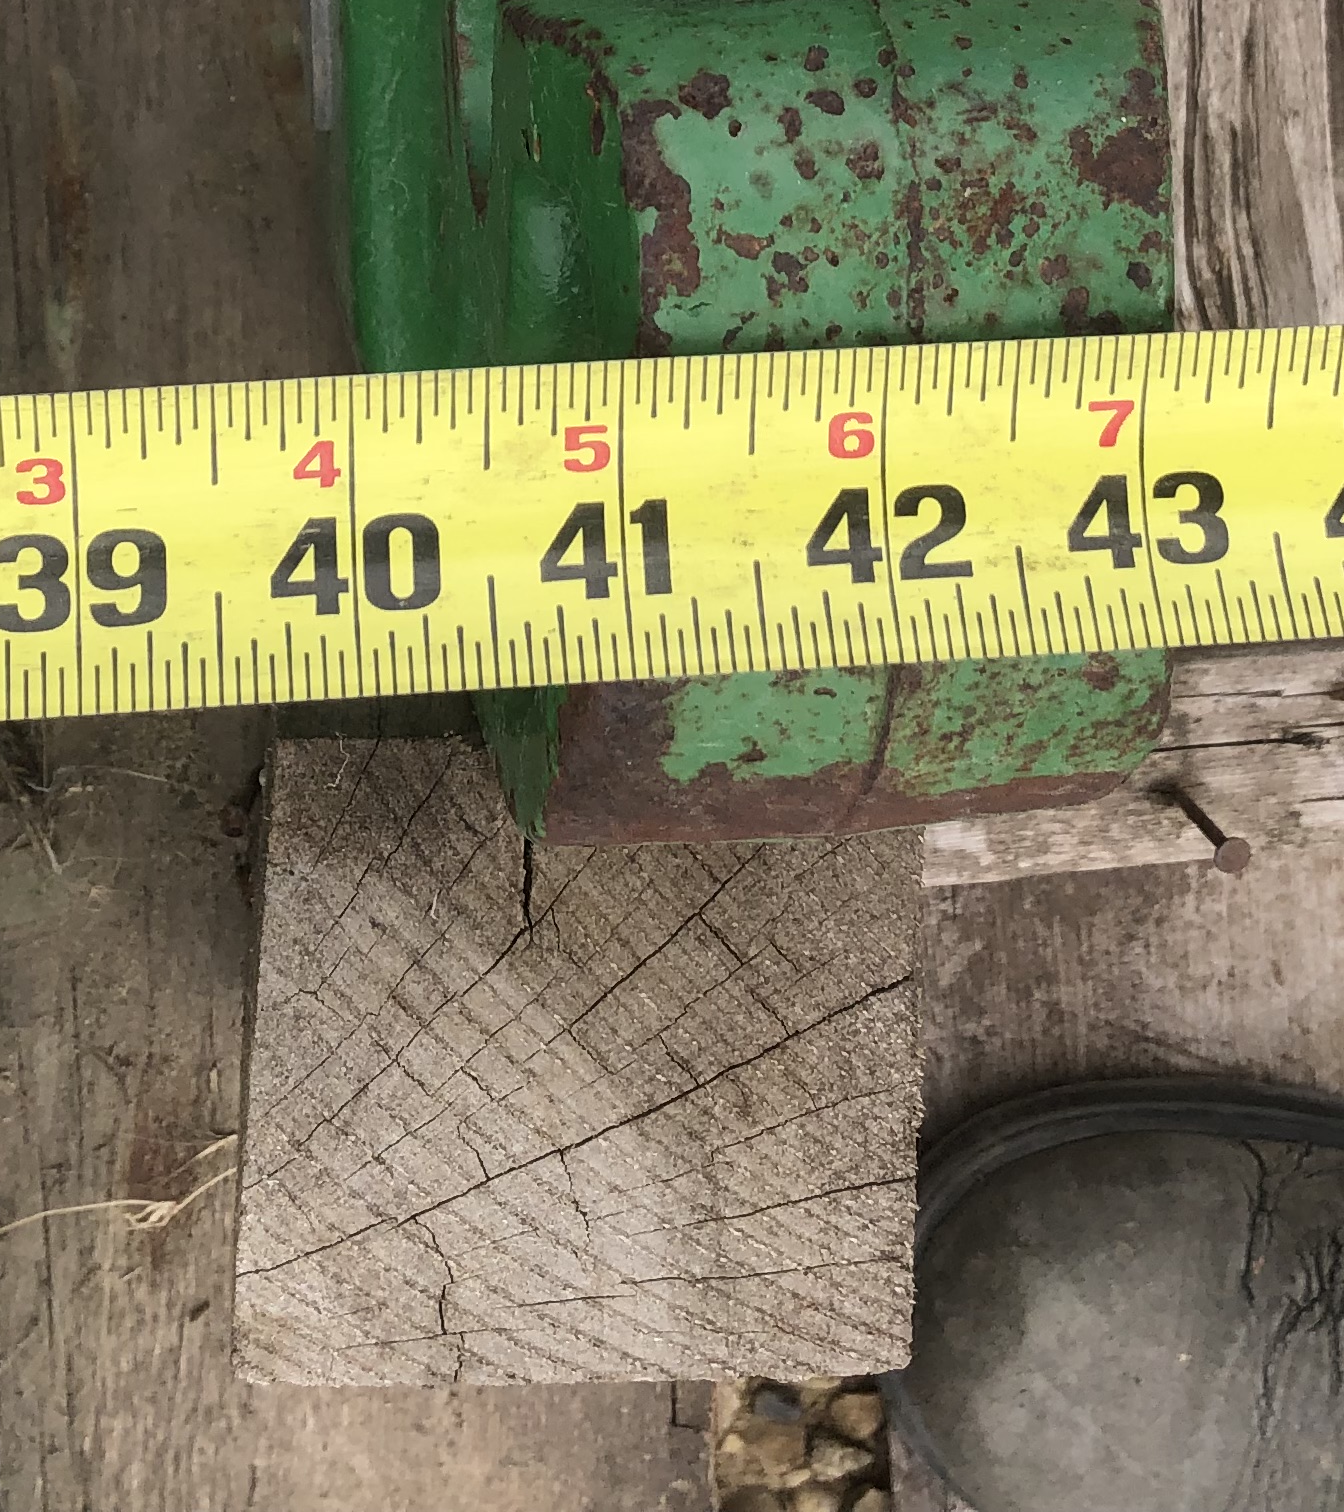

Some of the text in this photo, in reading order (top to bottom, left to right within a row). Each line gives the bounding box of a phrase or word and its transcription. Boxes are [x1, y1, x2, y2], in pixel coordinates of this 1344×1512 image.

[16, 459, 66, 505] 3
[293, 440, 341, 487] 4
[563, 424, 610, 473] 5
[828, 411, 875, 459] 6
[1088, 400, 1135, 448] 7
[270, 512, 441, 616] 40
[540, 498, 673, 600] 41
[806, 484, 973, 584] 42
[1067, 471, 1230, 569] 43
